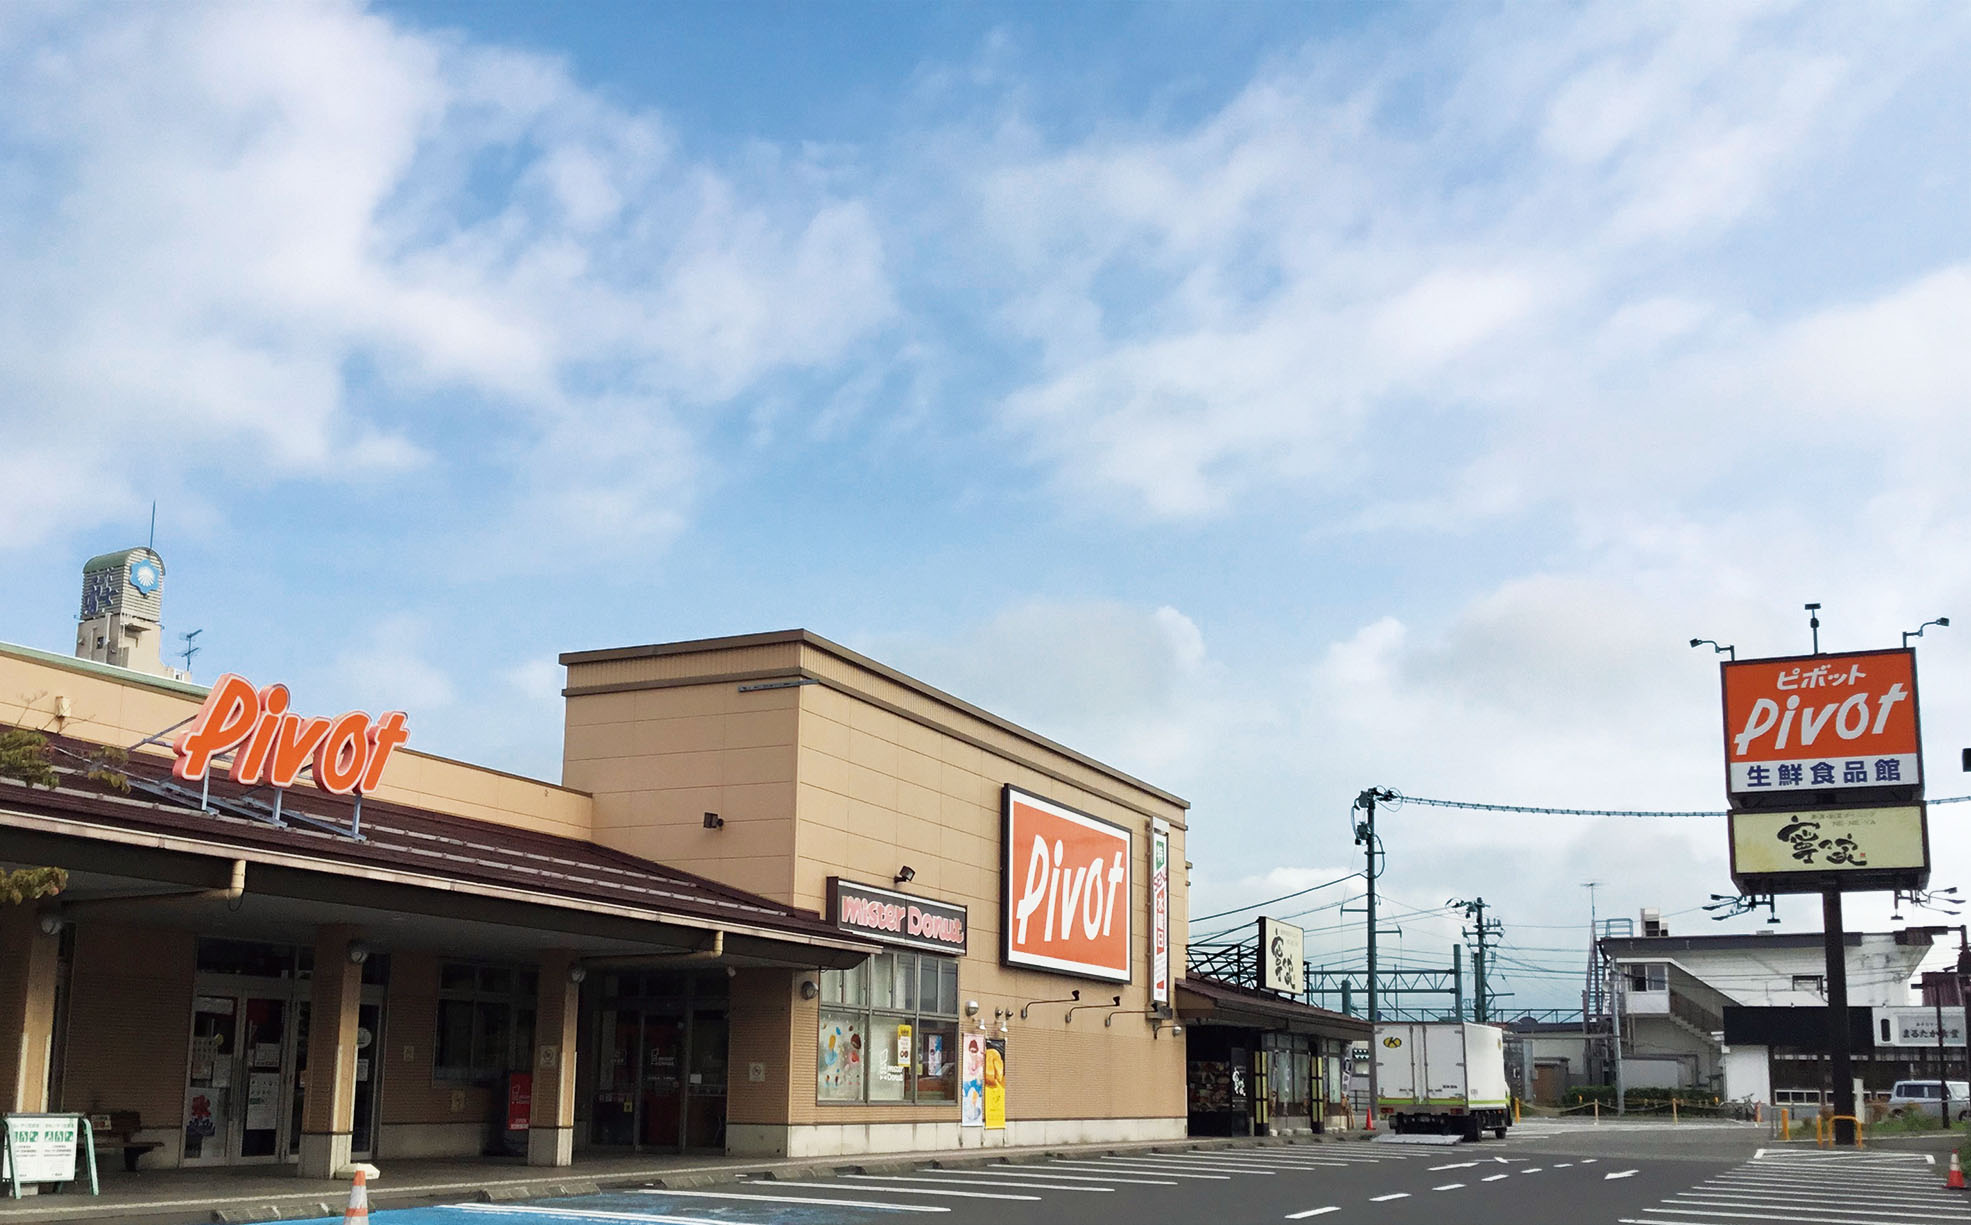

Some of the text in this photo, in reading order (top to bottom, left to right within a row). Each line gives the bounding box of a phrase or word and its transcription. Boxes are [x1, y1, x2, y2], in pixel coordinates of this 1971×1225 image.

[1776, 664, 1867, 690] ピボット
[173, 672, 412, 794] Pivot
[1734, 683, 1908, 755] Pivot
[1747, 758, 1901, 787] 生鮮食品館
[1016, 834, 1124, 944] Pivot
[907, 905, 964, 944] Donut
